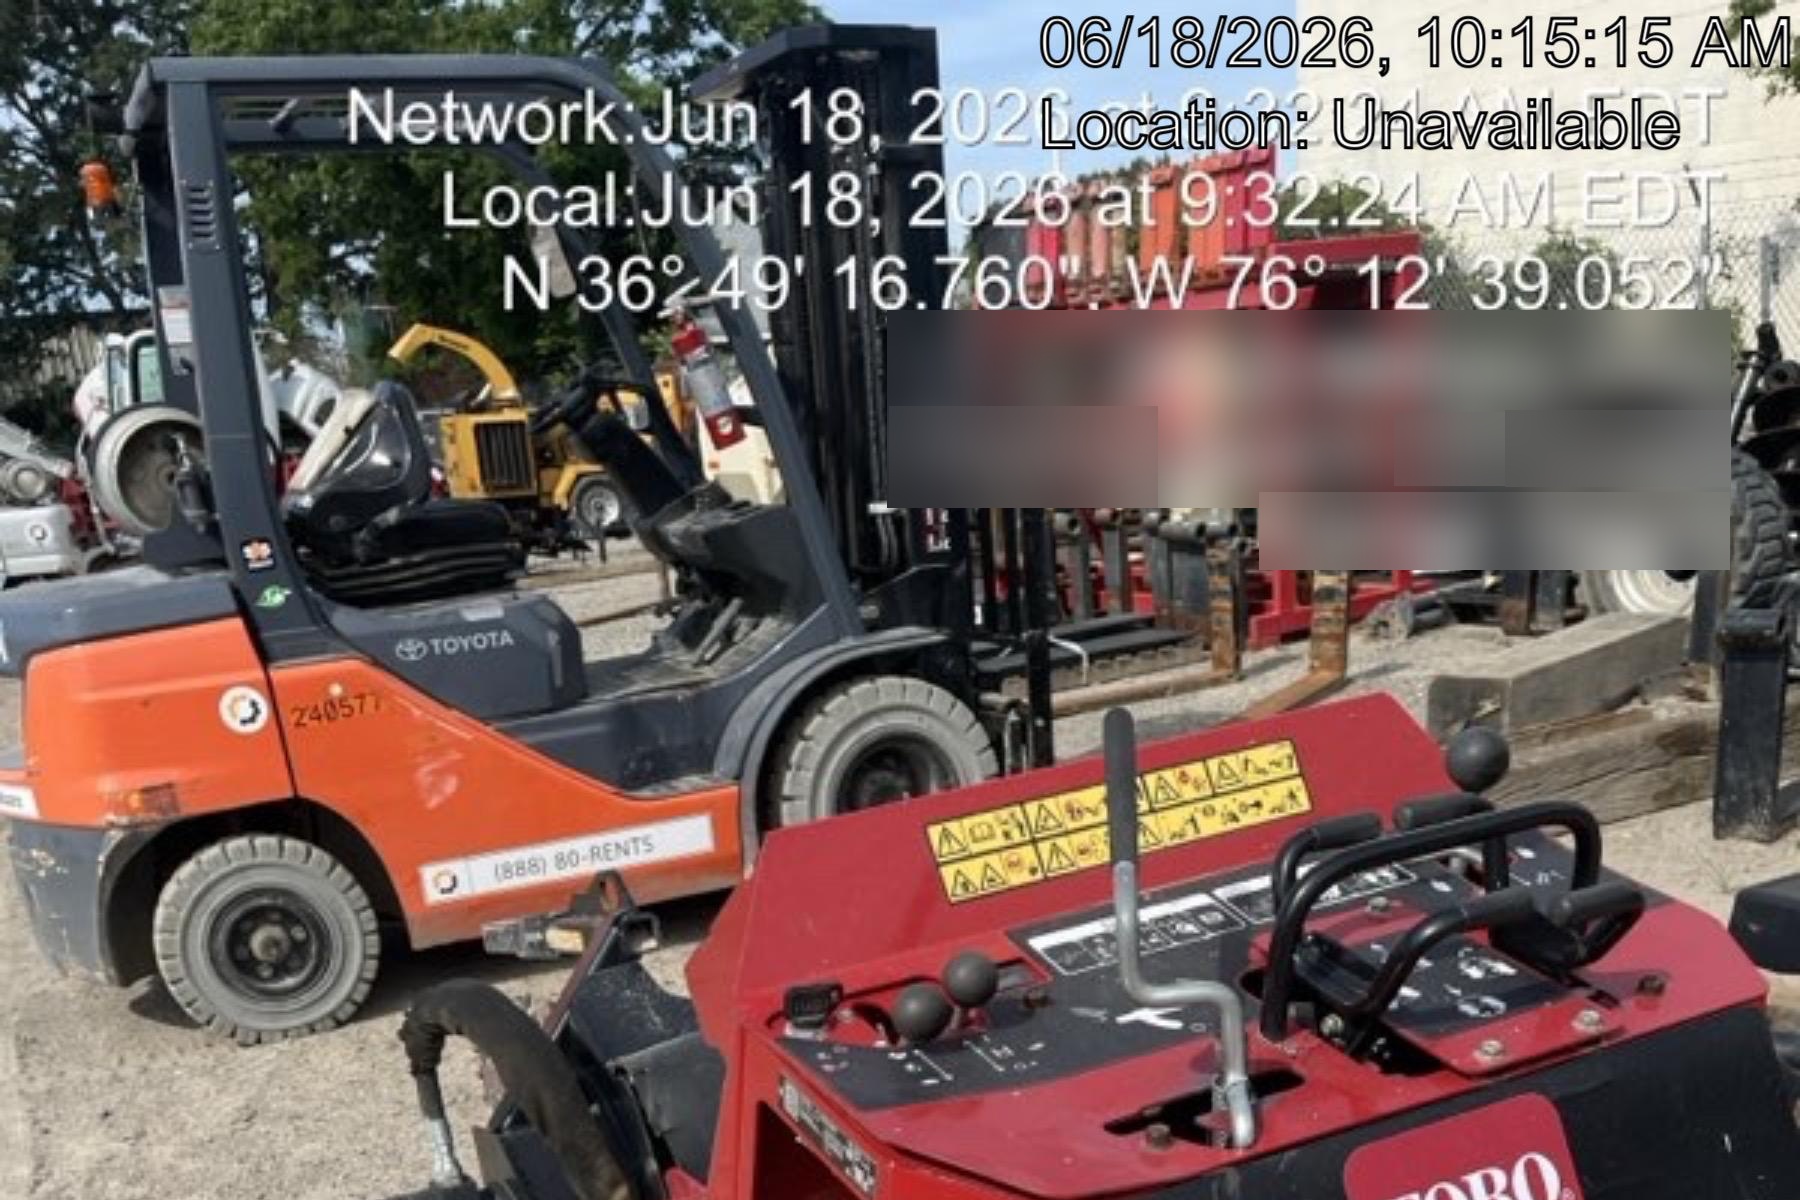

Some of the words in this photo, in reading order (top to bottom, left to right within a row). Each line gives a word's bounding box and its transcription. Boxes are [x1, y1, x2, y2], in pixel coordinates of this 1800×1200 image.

[429, 630, 515, 656] TOYOTA
[494, 858, 548, 882] (888)
[554, 834, 655, 872] 80-RENTS
